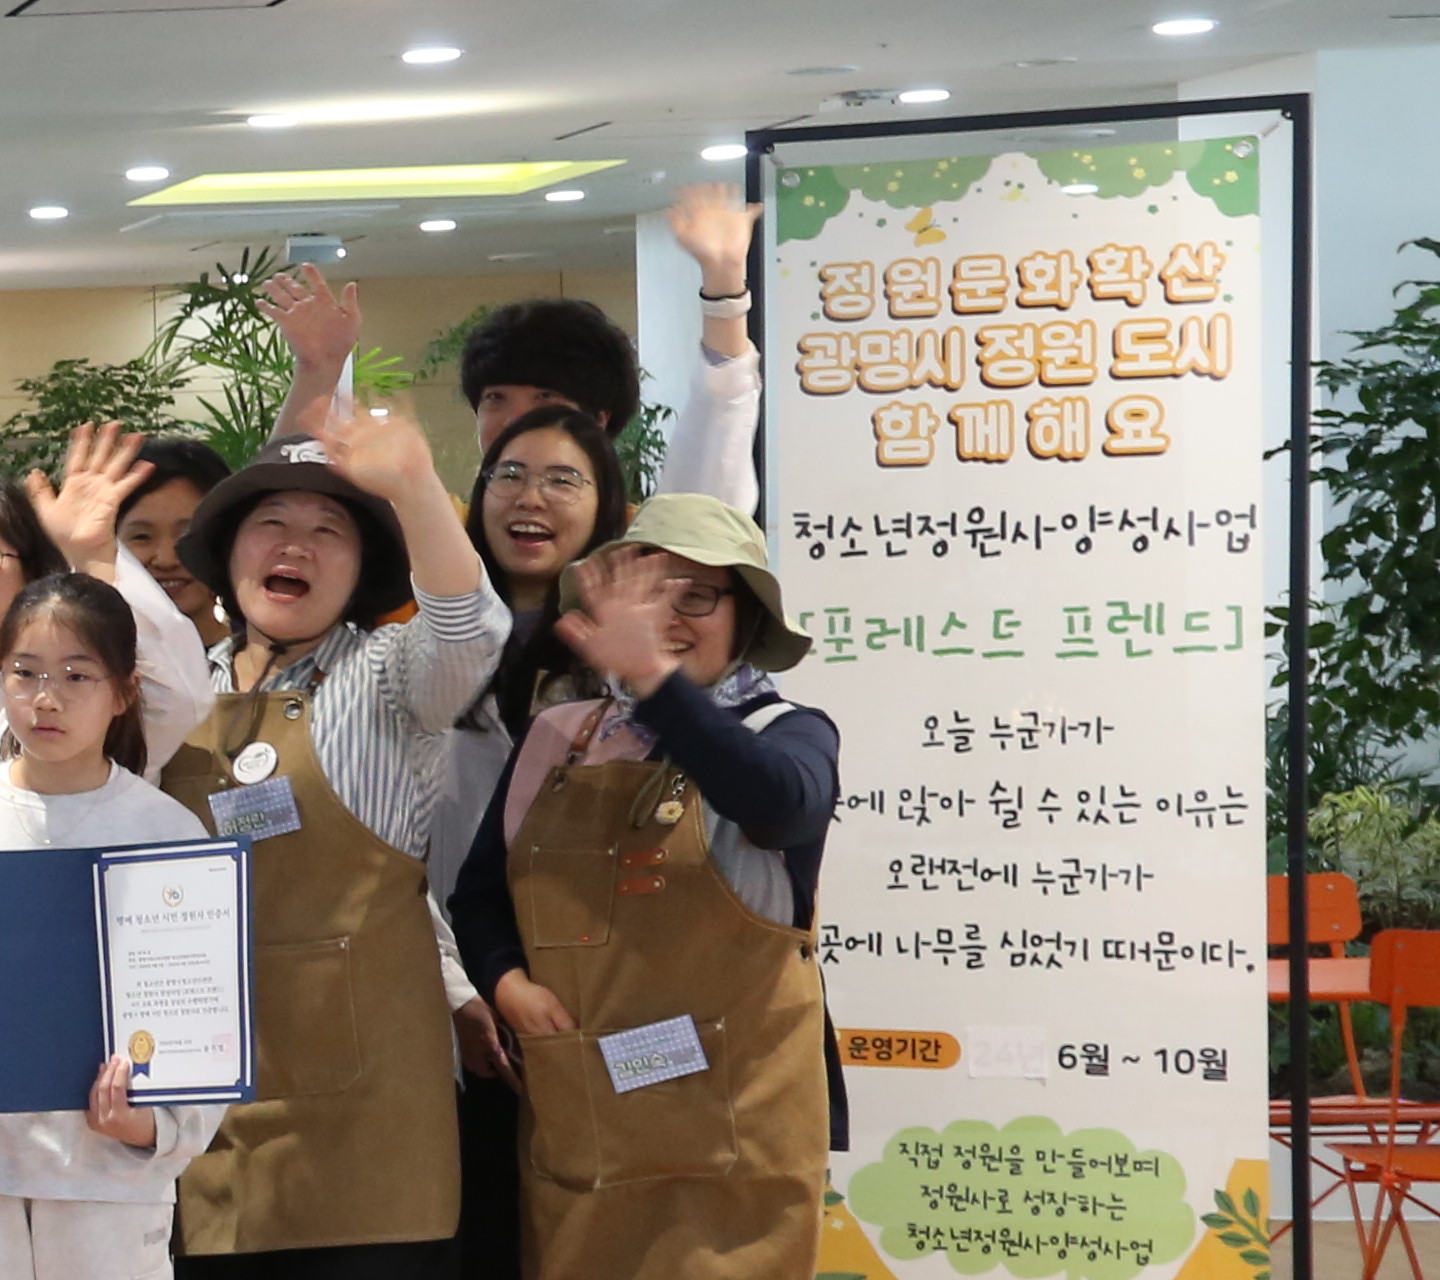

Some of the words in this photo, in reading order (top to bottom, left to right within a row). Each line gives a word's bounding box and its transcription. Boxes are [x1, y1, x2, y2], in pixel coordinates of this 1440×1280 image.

[798, 327, 966, 394] 광명시
[979, 320, 1096, 388] 정원
[1109, 313, 1233, 379] 도시
[793, 505, 1257, 559] 청소년정원사양성사업
[1056, 600, 1244, 660] 프렌드]
[921, 711, 976, 753] 오늘
[988, 709, 1115, 751] 누군가가
[898, 785, 976, 827] 앉아
[988, 780, 1023, 829] 쉴
[1037, 791, 1063, 824] 수
[1077, 785, 1141, 825] 있는
[1156, 785, 1249, 828] 이유는
[886, 854, 1018, 891] 오랜전에
[1031, 858, 1155, 896] 누군가가
[895, 924, 987, 969] 나무를
[1000, 928, 1089, 970] 심었기
[1102, 930, 1256, 974] 때문이다.
[847, 1035, 941, 1062] 운영기간
[1057, 1044, 1110, 1077] 6월
[1153, 1048, 1229, 1081] 10월
[898, 1141, 943, 1169] 직접
[953, 1143, 1025, 1176] 정원을
[1036, 1149, 1159, 1179] 만들어보며
[920, 1183, 1013, 1214] 정원사로
[1023, 1190, 1127, 1221] 성장하는
[907, 1222, 1154, 1266] 청소년정원사양성사업
